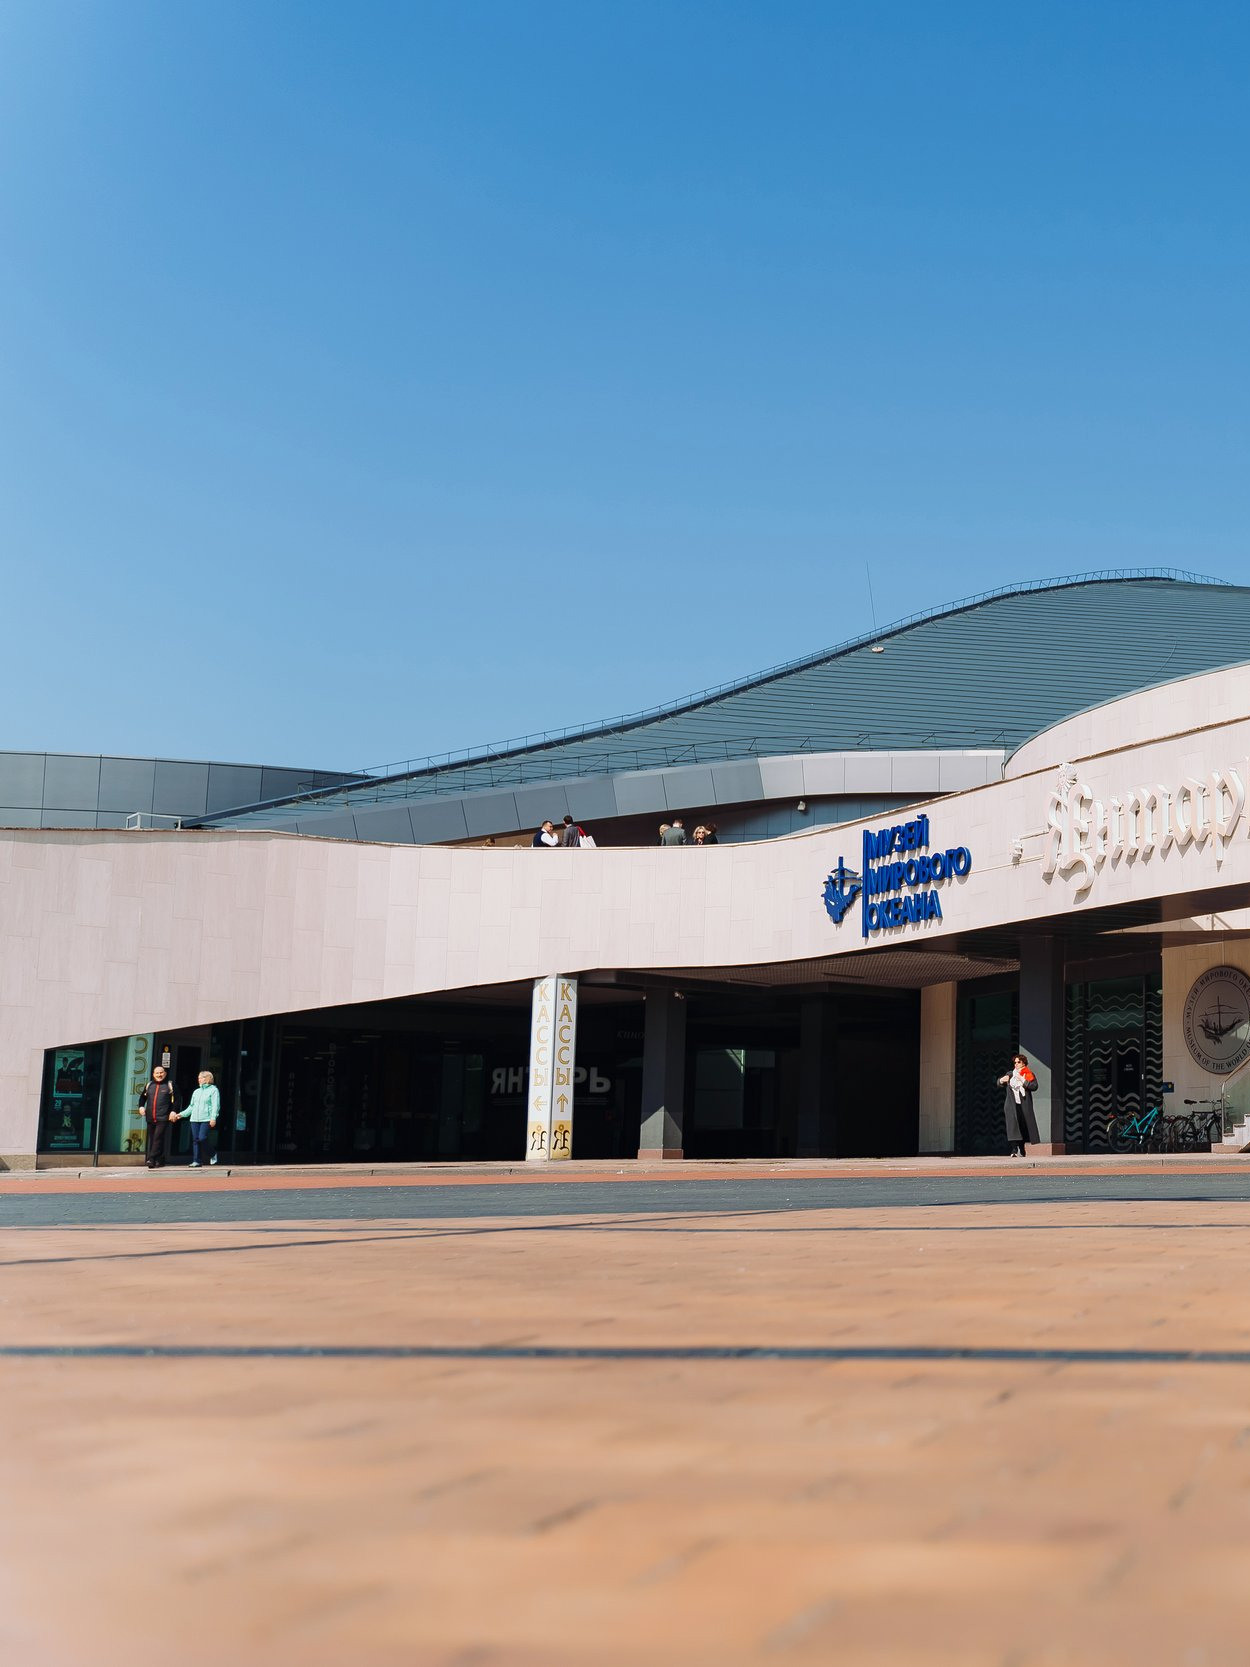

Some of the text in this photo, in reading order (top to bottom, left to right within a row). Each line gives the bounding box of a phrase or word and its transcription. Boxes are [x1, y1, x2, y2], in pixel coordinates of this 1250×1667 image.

[868, 814, 929, 859] МУЗЕЙ
[868, 847, 972, 895] МИРОВОГО
[866, 890, 943, 930] ОКЕАНА
[532, 983, 551, 1087] КАССЫ
[555, 983, 573, 1086] КАССЫ
[1185, 1025, 1204, 1061] MUSEUM
[1212, 1063, 1224, 1071] THE
[1225, 1048, 1249, 1068] WORLD
[490, 1066, 612, 1095] ЯНРЬ
